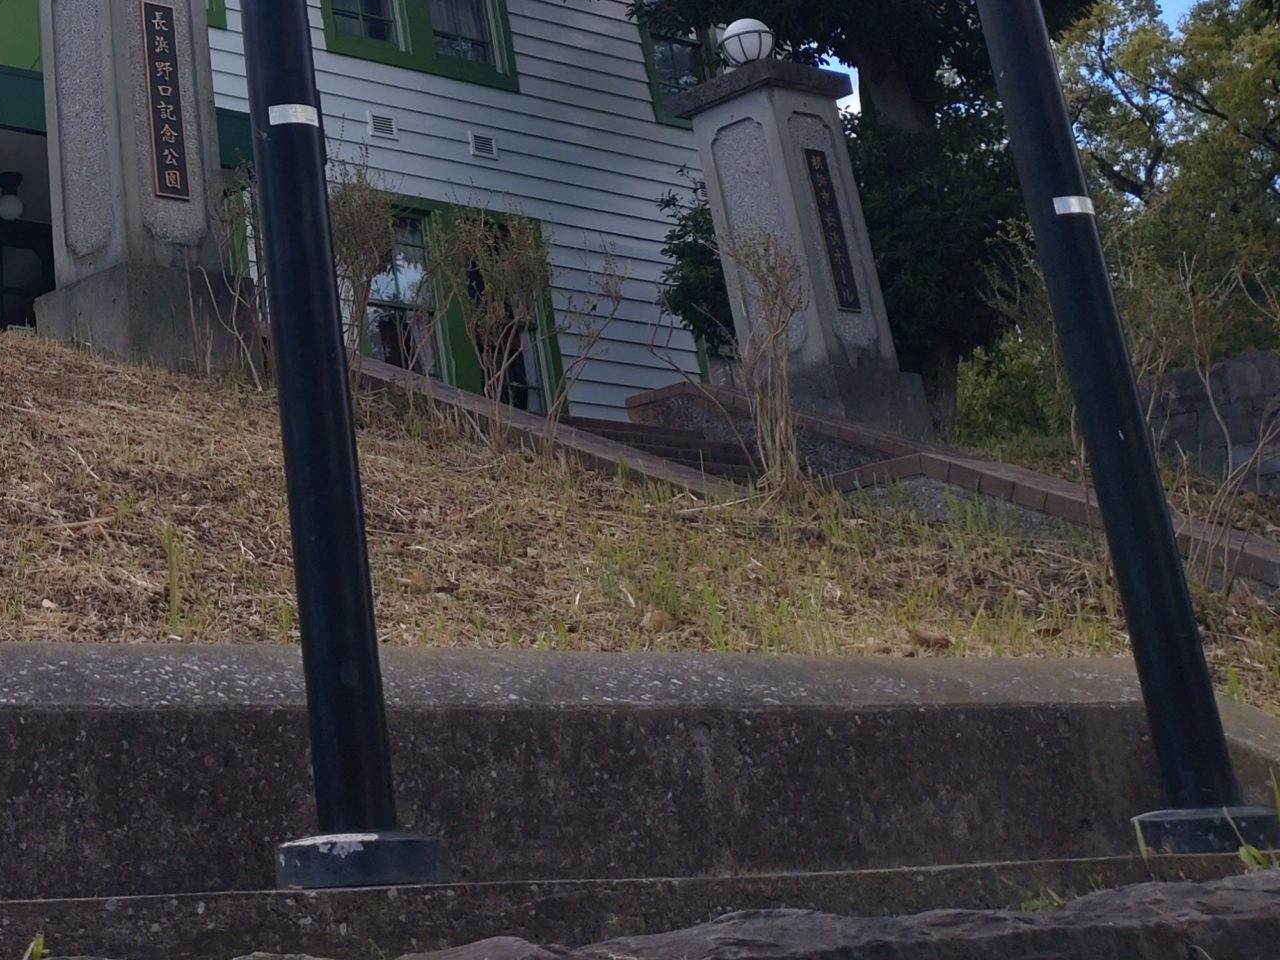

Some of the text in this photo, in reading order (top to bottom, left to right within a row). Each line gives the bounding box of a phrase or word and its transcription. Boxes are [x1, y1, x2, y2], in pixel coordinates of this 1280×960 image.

[151, 11, 182, 189] 長浜野口記念公園
